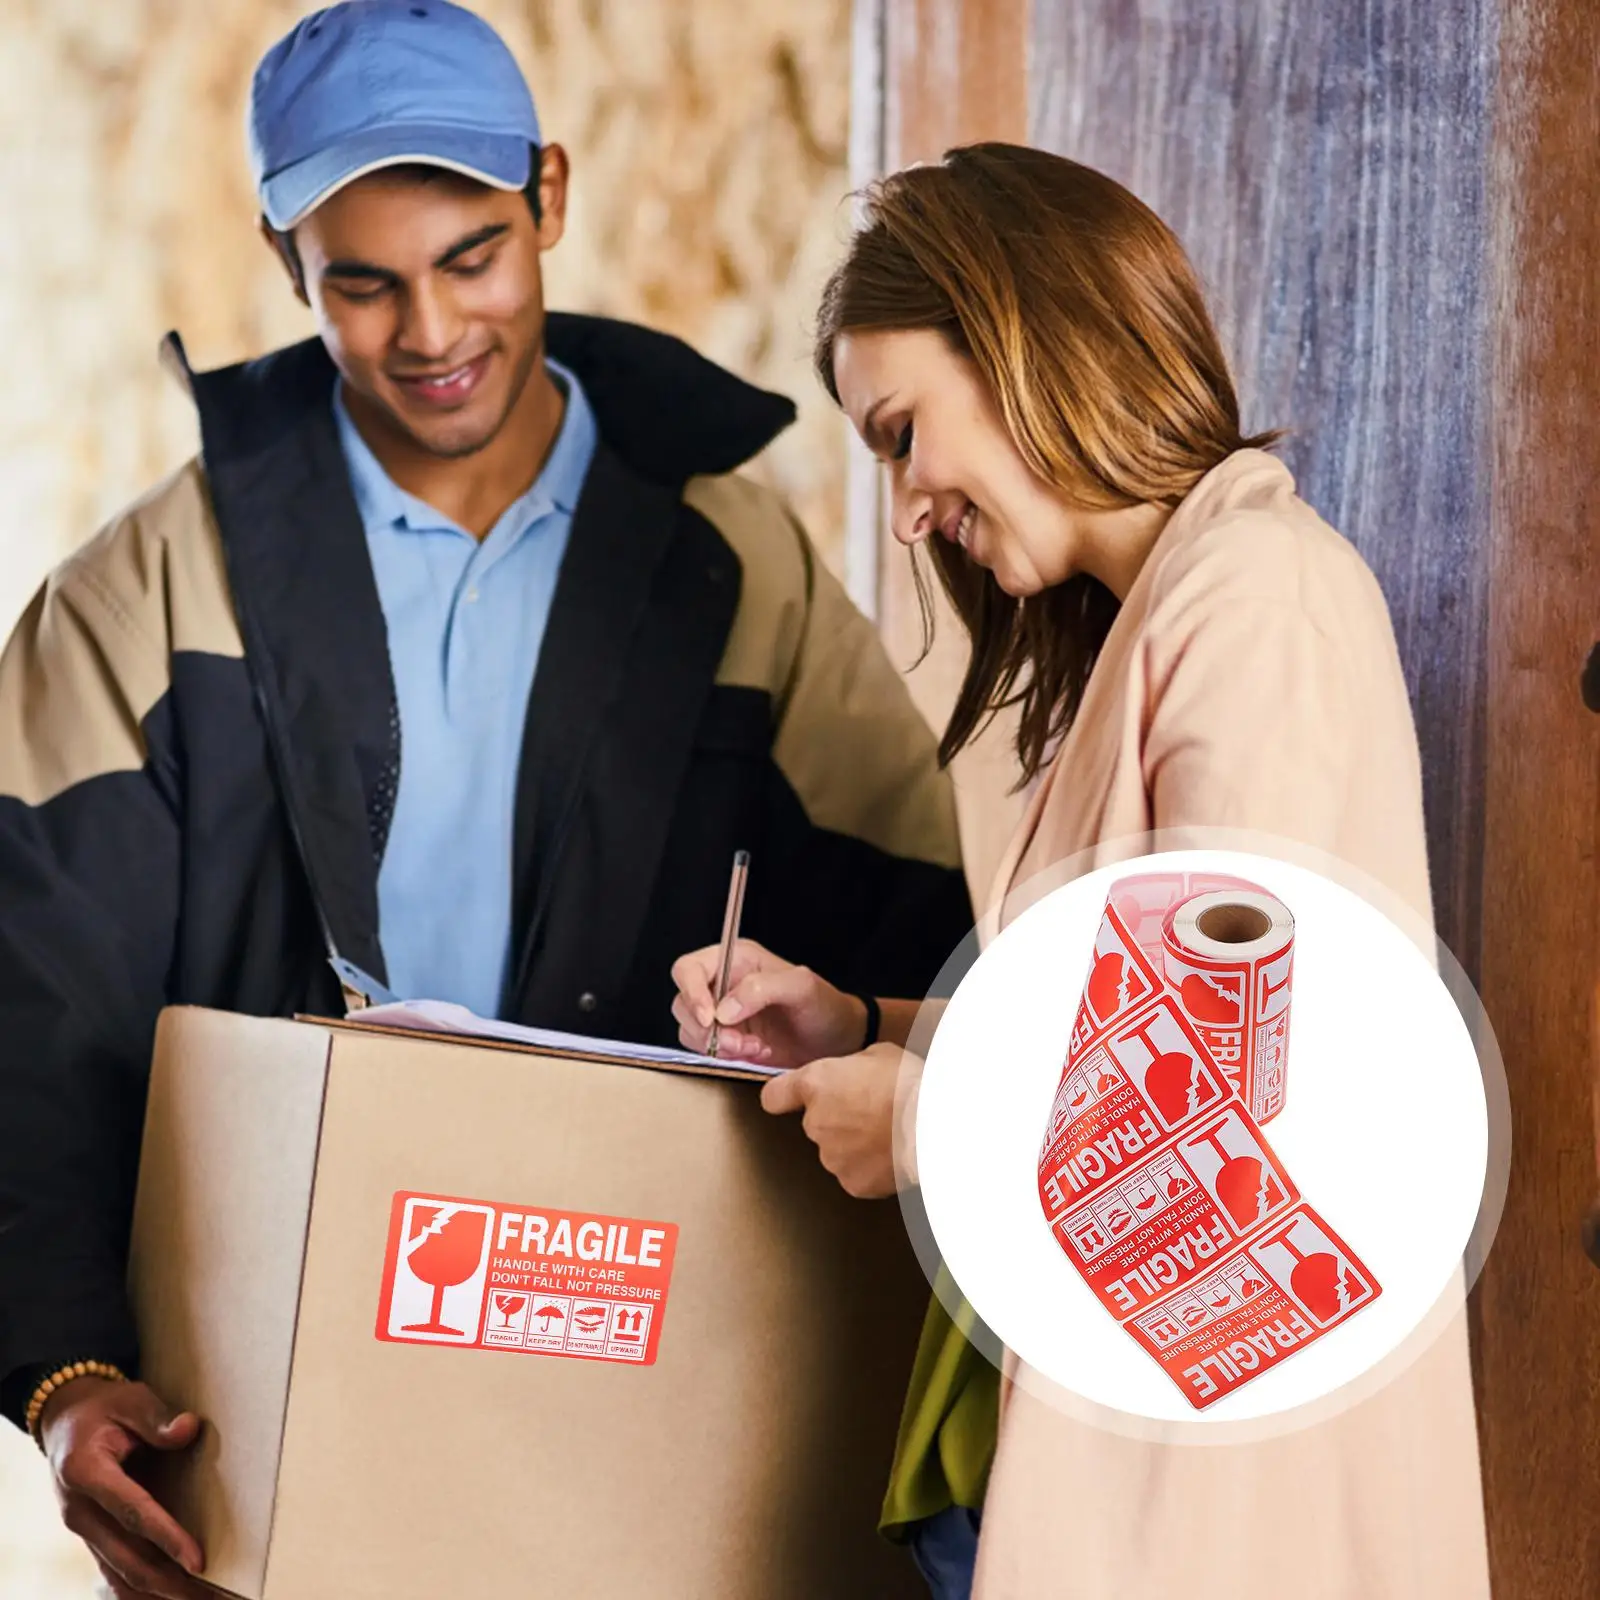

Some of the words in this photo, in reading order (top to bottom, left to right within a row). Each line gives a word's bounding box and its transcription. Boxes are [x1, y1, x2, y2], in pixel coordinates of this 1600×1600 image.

[1106, 1087, 1134, 1110] DON'T
[1083, 1106, 1106, 1123] FALL
[1103, 1096, 1141, 1127] HANDLE
[1067, 1122, 1084, 1139] NOT
[1077, 1123, 1102, 1144] WITH
[1044, 1109, 1162, 1211] FRAGILE
[1055, 1141, 1077, 1164] CARE
[1178, 1191, 1206, 1215] DON'T
[1154, 1211, 1178, 1229] FALL
[1173, 1201, 1212, 1232] HANDLE
[497, 1212, 665, 1268] FRAGILE
[1136, 1225, 1155, 1242] NOT
[1147, 1227, 1174, 1248] WITH
[1085, 1238, 1135, 1277] PRESSURE
[1105, 1214, 1233, 1312] FRAGILE
[1119, 1245, 1147, 1268] CARE
[493, 1257, 549, 1273] HANDLE
[552, 1264, 585, 1277] WITH
[588, 1268, 625, 1282] CARE
[491, 1272, 531, 1285] DON'T
[532, 1276, 562, 1290] FALL
[566, 1281, 593, 1293] NOT
[595, 1284, 661, 1299] PRESSURE
[1251, 1298, 1289, 1325] HANDLE
[1255, 1290, 1281, 1312] DON'T
[1212, 1320, 1232, 1336] NOT
[1230, 1308, 1254, 1325] FALL
[490, 1334, 519, 1342] FRAGILE
[1225, 1319, 1251, 1338] WITH
[610, 1346, 639, 1354] UPWARD
[1161, 1329, 1212, 1361] PRESSURE
[1182, 1309, 1315, 1399] FRAGILE
[1199, 1334, 1225, 1354] CARE
